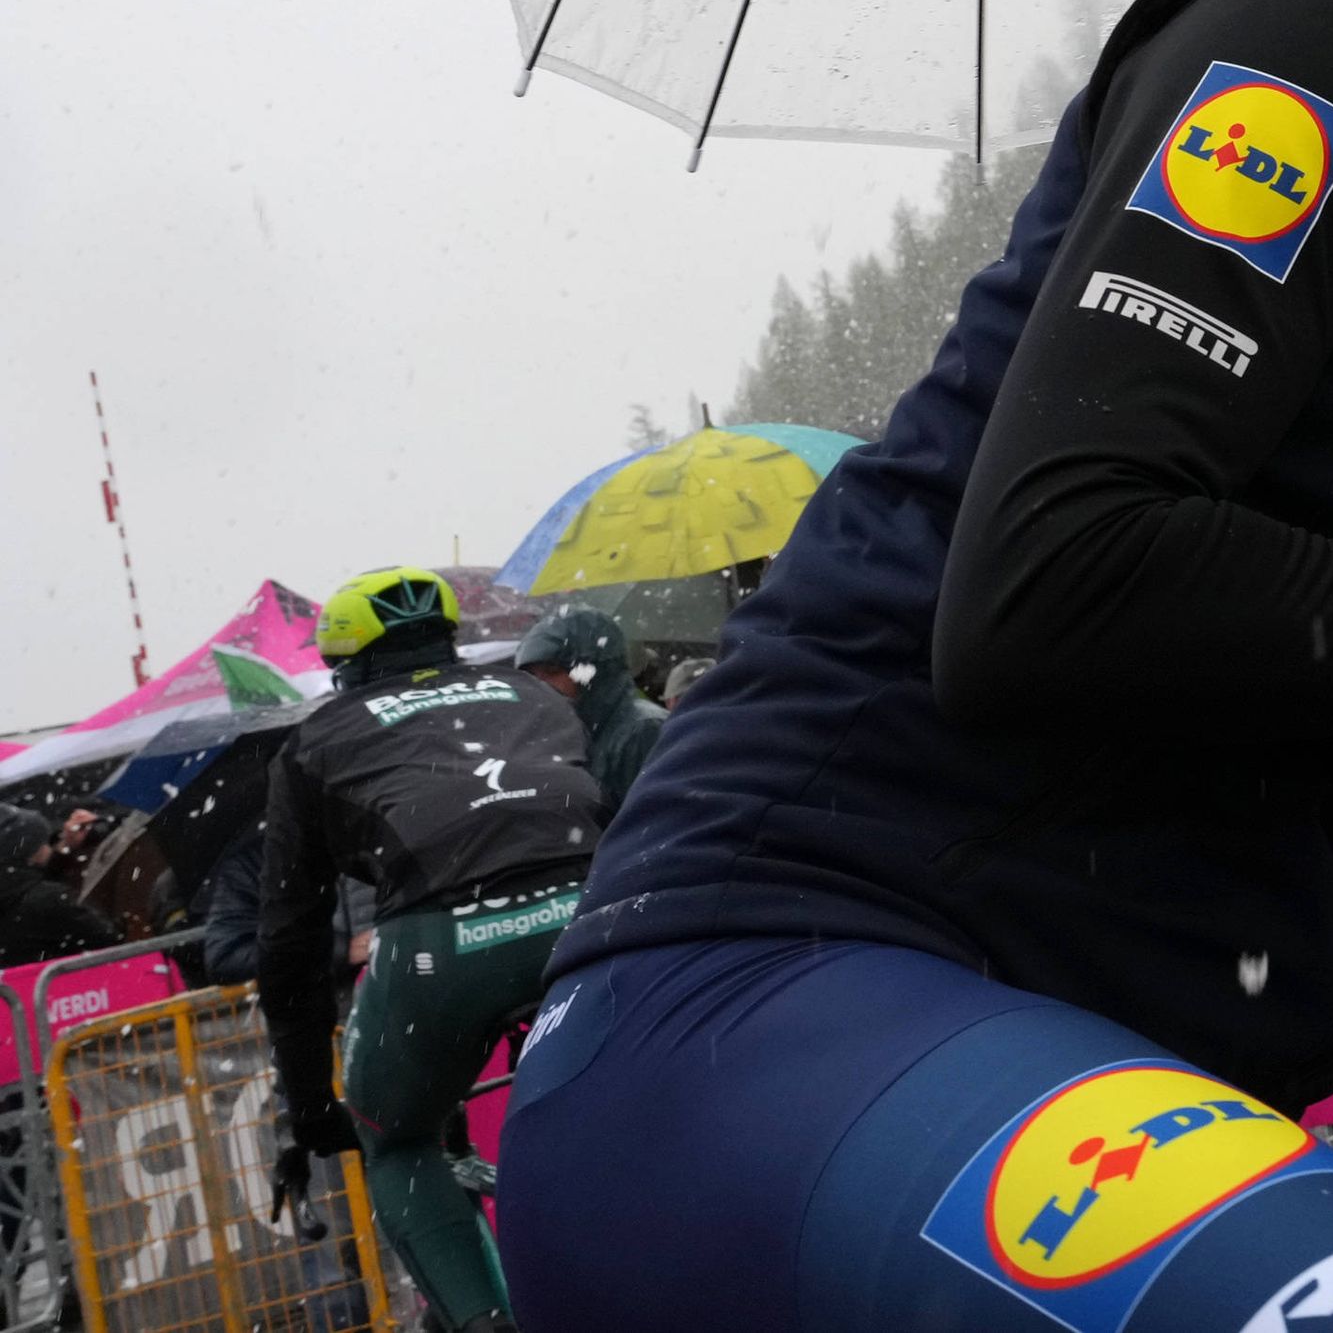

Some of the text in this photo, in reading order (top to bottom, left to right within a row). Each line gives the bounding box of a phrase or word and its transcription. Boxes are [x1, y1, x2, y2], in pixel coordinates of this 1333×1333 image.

[1078, 270, 1259, 378] PIRELLI
[364, 679, 512, 716] BORA
[380, 689, 514, 724] hansgrohe
[457, 898, 580, 947] hansgrohe
[47, 987, 109, 1025] VERDI
